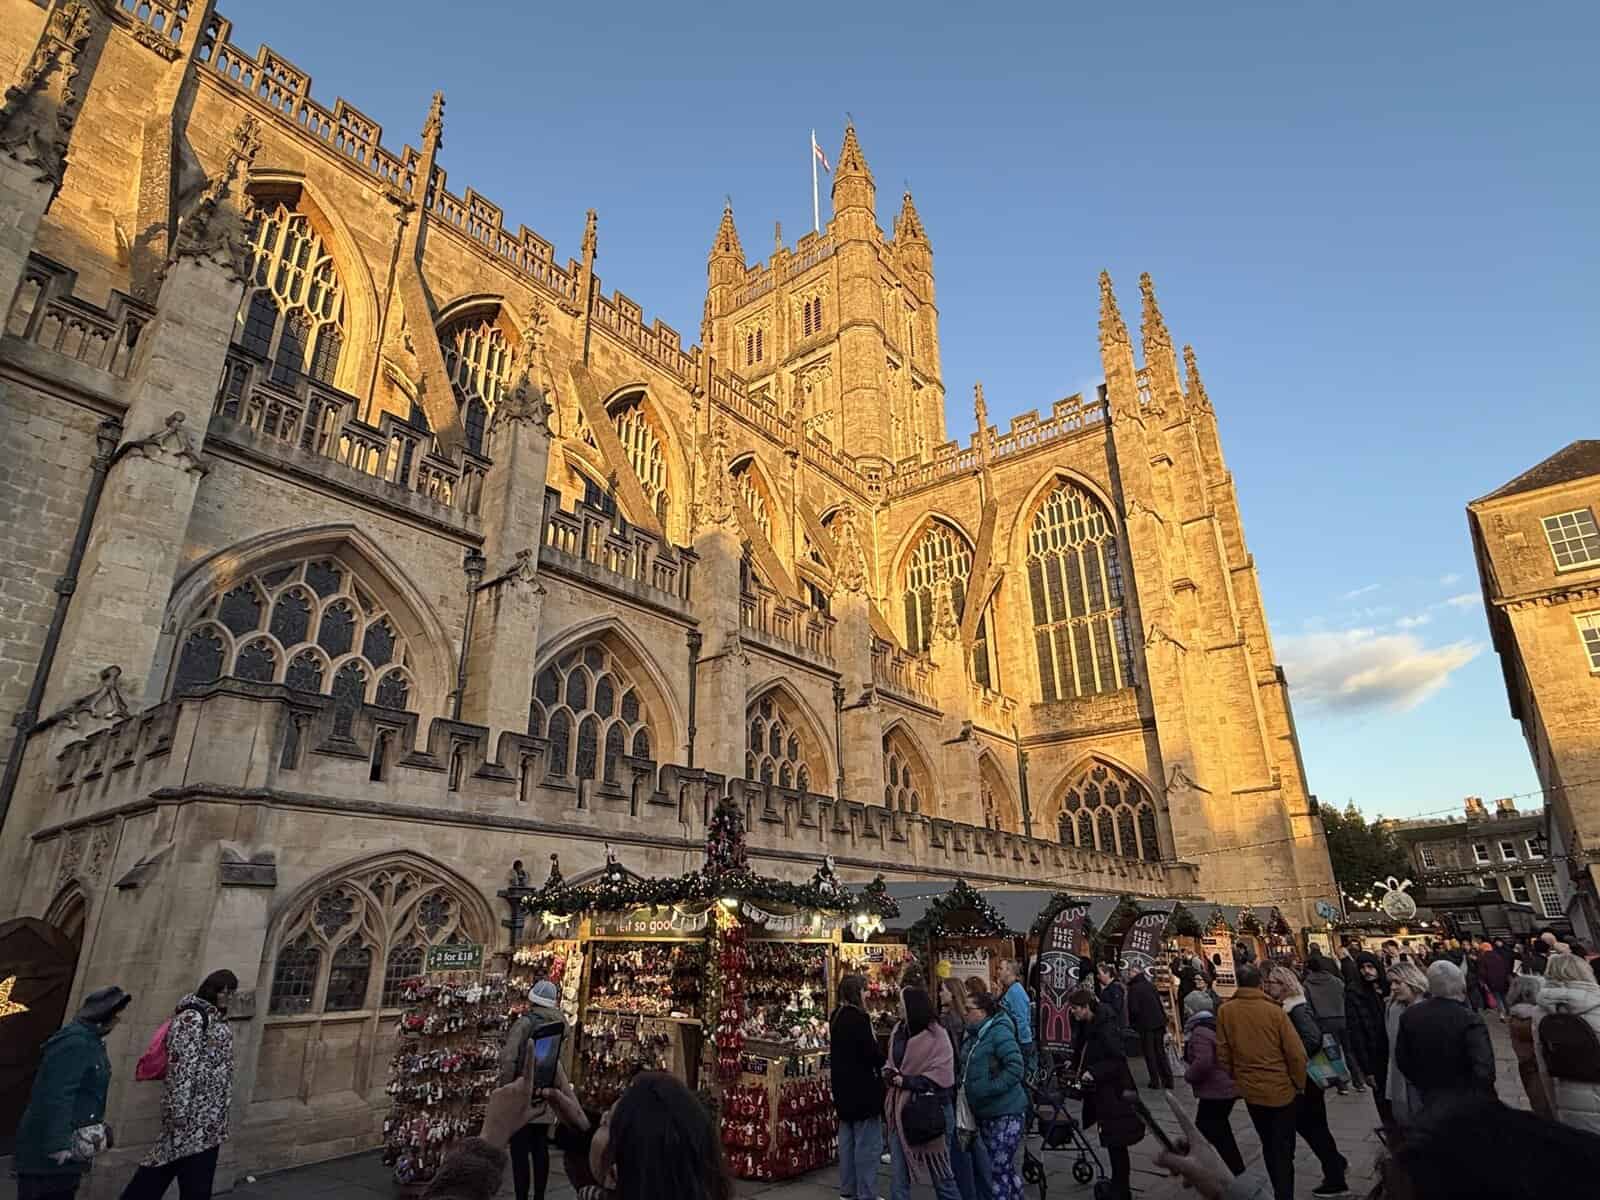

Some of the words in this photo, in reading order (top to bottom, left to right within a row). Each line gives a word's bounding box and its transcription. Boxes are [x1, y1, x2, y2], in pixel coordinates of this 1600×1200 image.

[634, 921, 646, 932] so
[649, 920, 673, 935] goo
[436, 952, 443, 961] 2
[444, 952, 457, 961] for
